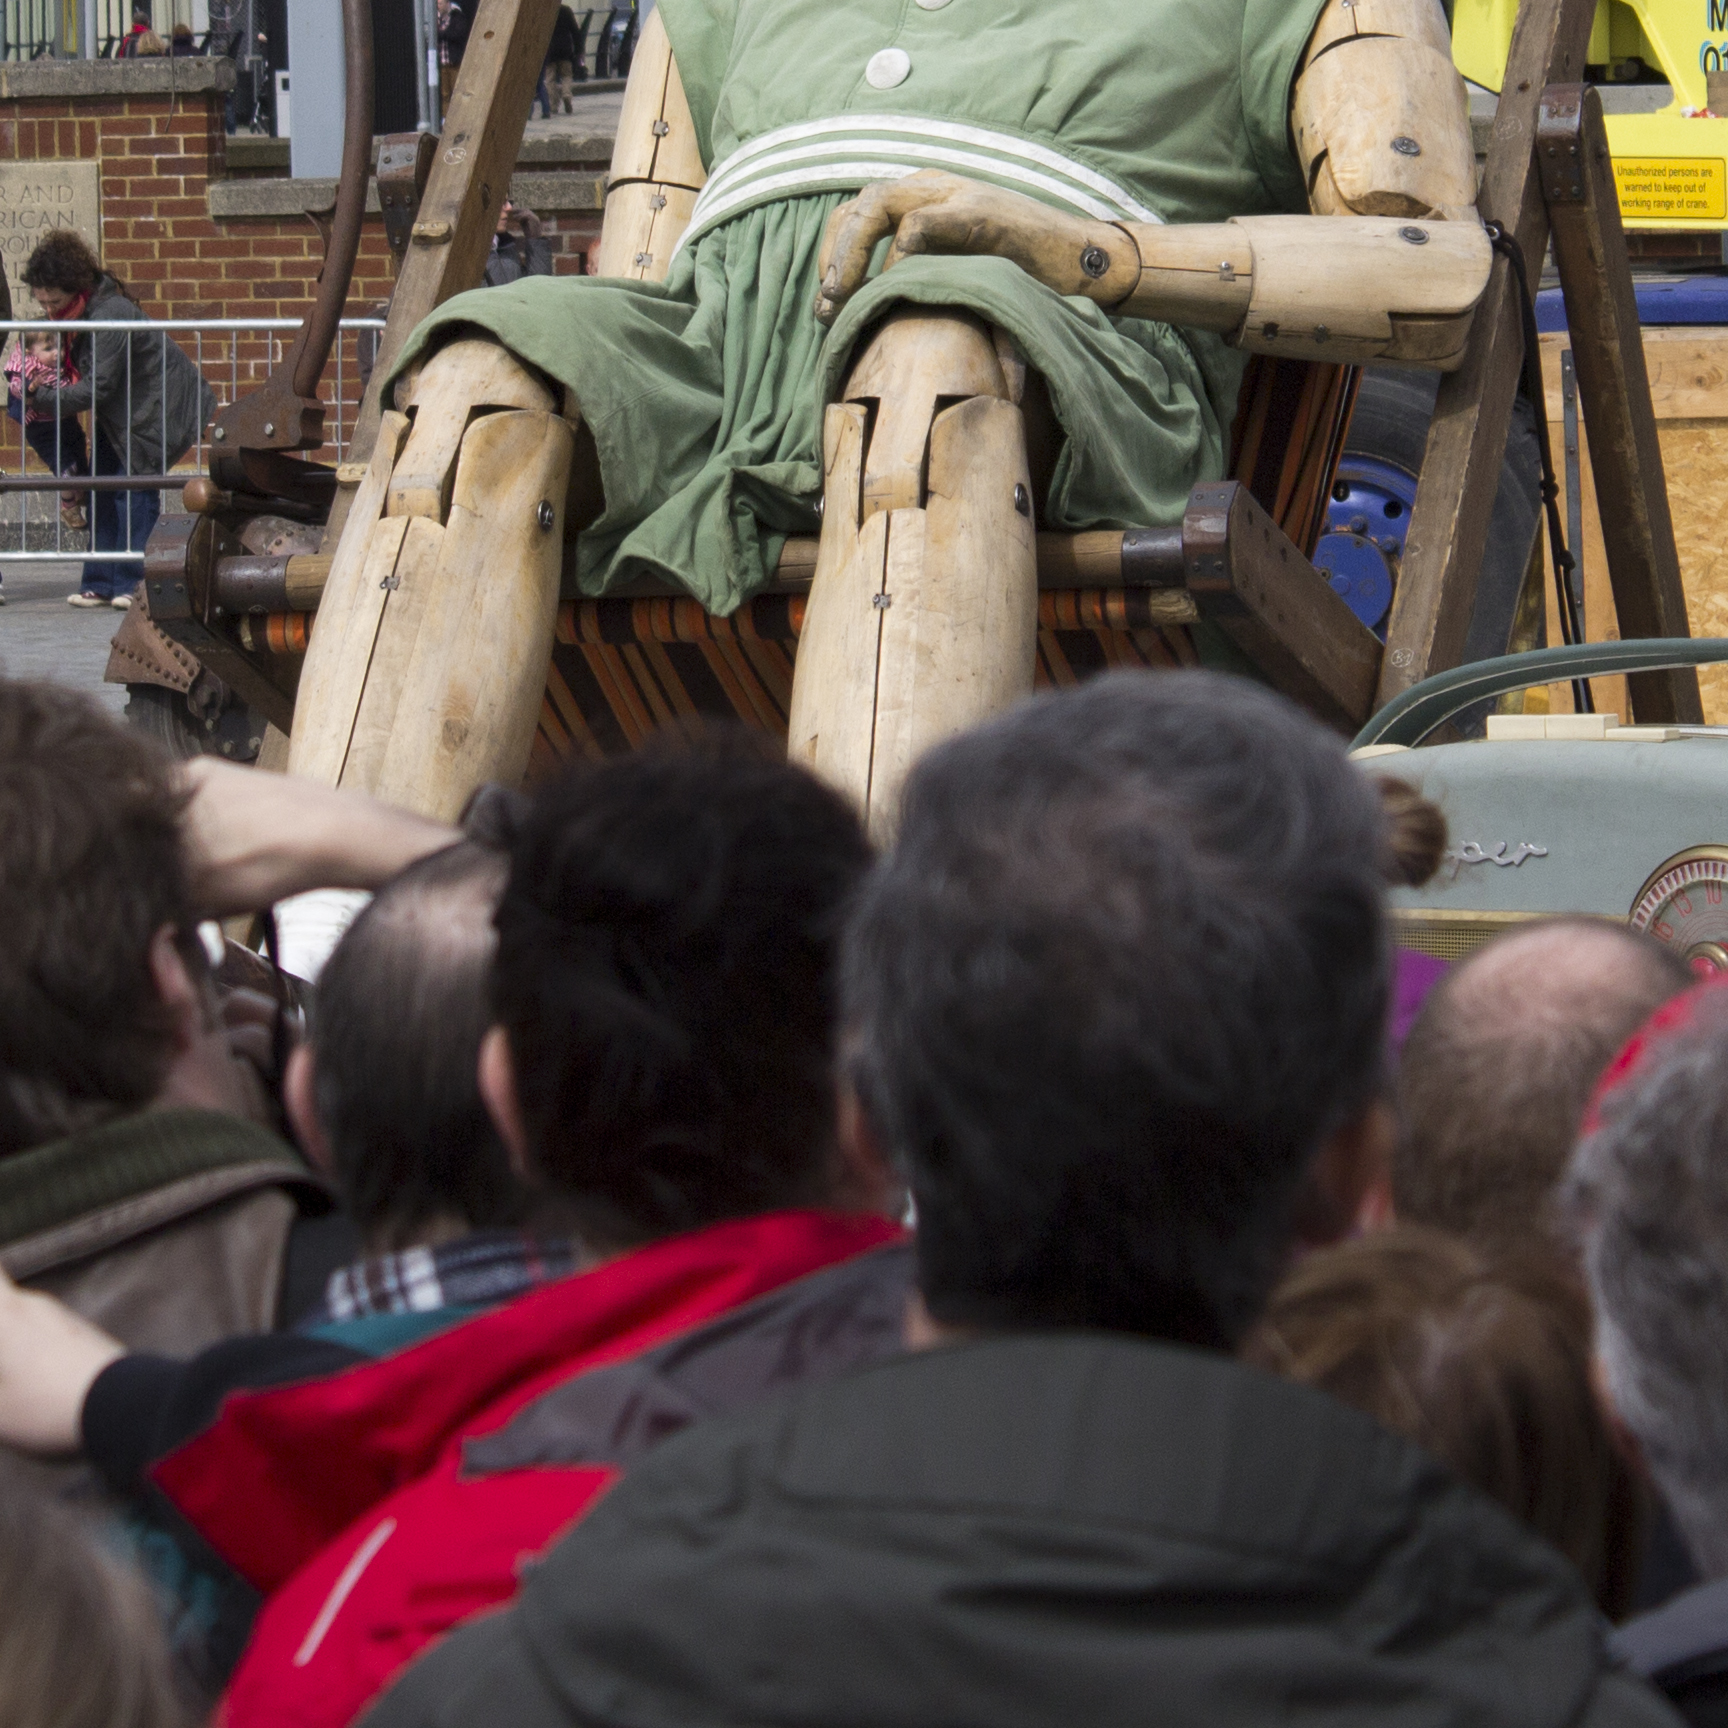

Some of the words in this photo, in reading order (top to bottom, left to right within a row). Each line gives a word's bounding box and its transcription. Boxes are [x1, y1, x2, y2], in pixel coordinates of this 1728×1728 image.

[1616, 165, 1668, 178] Unauthorized
[1668, 168, 1700, 179] persons
[1700, 168, 1714, 178] are
[19, 184, 74, 204] AND
[1624, 182, 1653, 193] warned
[1654, 183, 1662, 193] to
[1663, 182, 1683, 195] keep
[1683, 183, 1697, 193] out
[1698, 182, 1707, 193] of
[1621, 197, 1652, 211] working
[1653, 199, 1675, 211] range
[1676, 198, 1685, 209] of
[1704, 879, 1722, 905] 10
